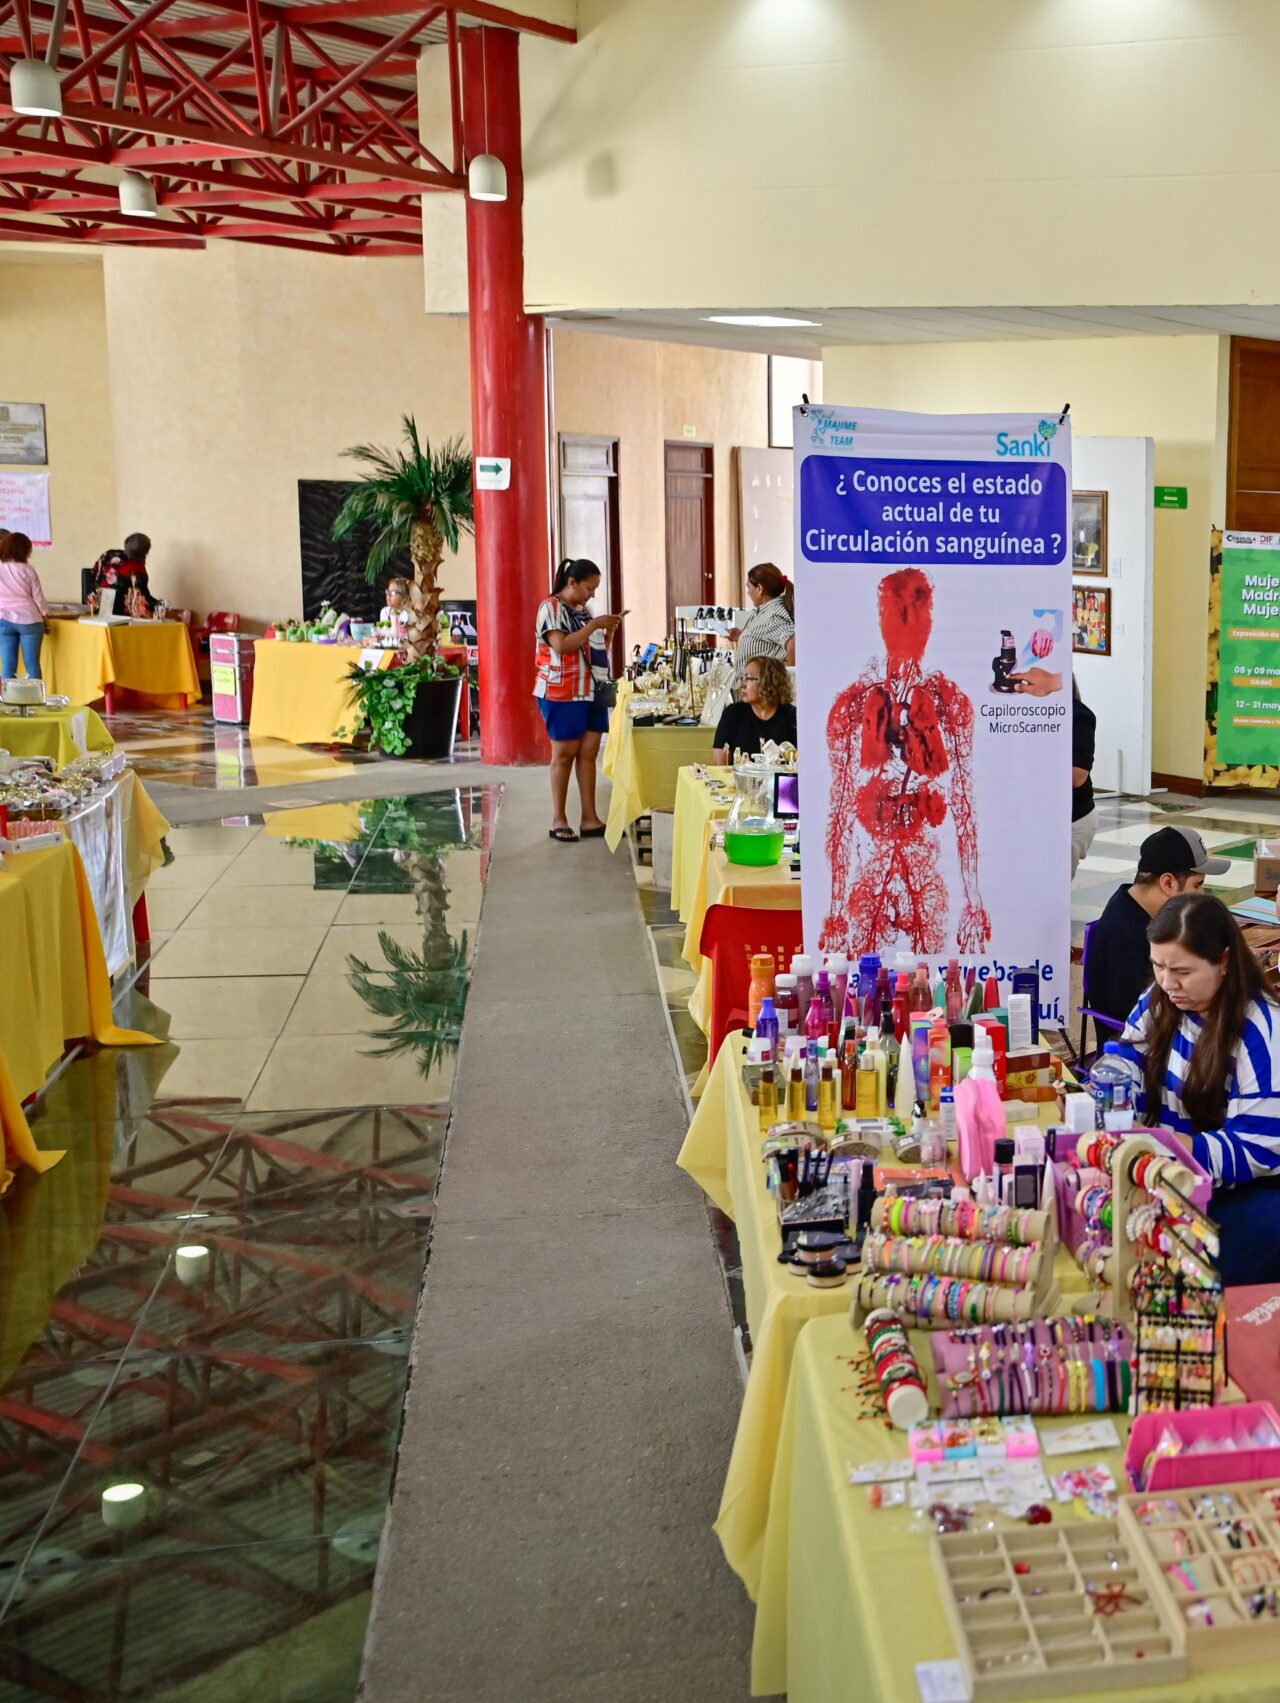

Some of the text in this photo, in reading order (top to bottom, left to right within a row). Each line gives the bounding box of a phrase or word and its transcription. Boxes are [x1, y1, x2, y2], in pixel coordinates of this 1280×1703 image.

[824, 419, 857, 431] MAJIME
[830, 435, 853, 446] TEAM
[996, 432, 1051, 457] Sanki
[853, 470, 941, 493] Conoces
[948, 472, 966, 494] el
[972, 474, 1043, 495] estado
[882, 502, 1000, 523] actual de tu
[805, 529, 929, 553] Circulación
[936, 532, 1044, 559] sanguínea
[980, 704, 1066, 719] Capiloroscopio
[1236, 700, 1244, 708] 12
[1252, 701, 1261, 709] 31
[989, 721, 1061, 734] MicroScanner
